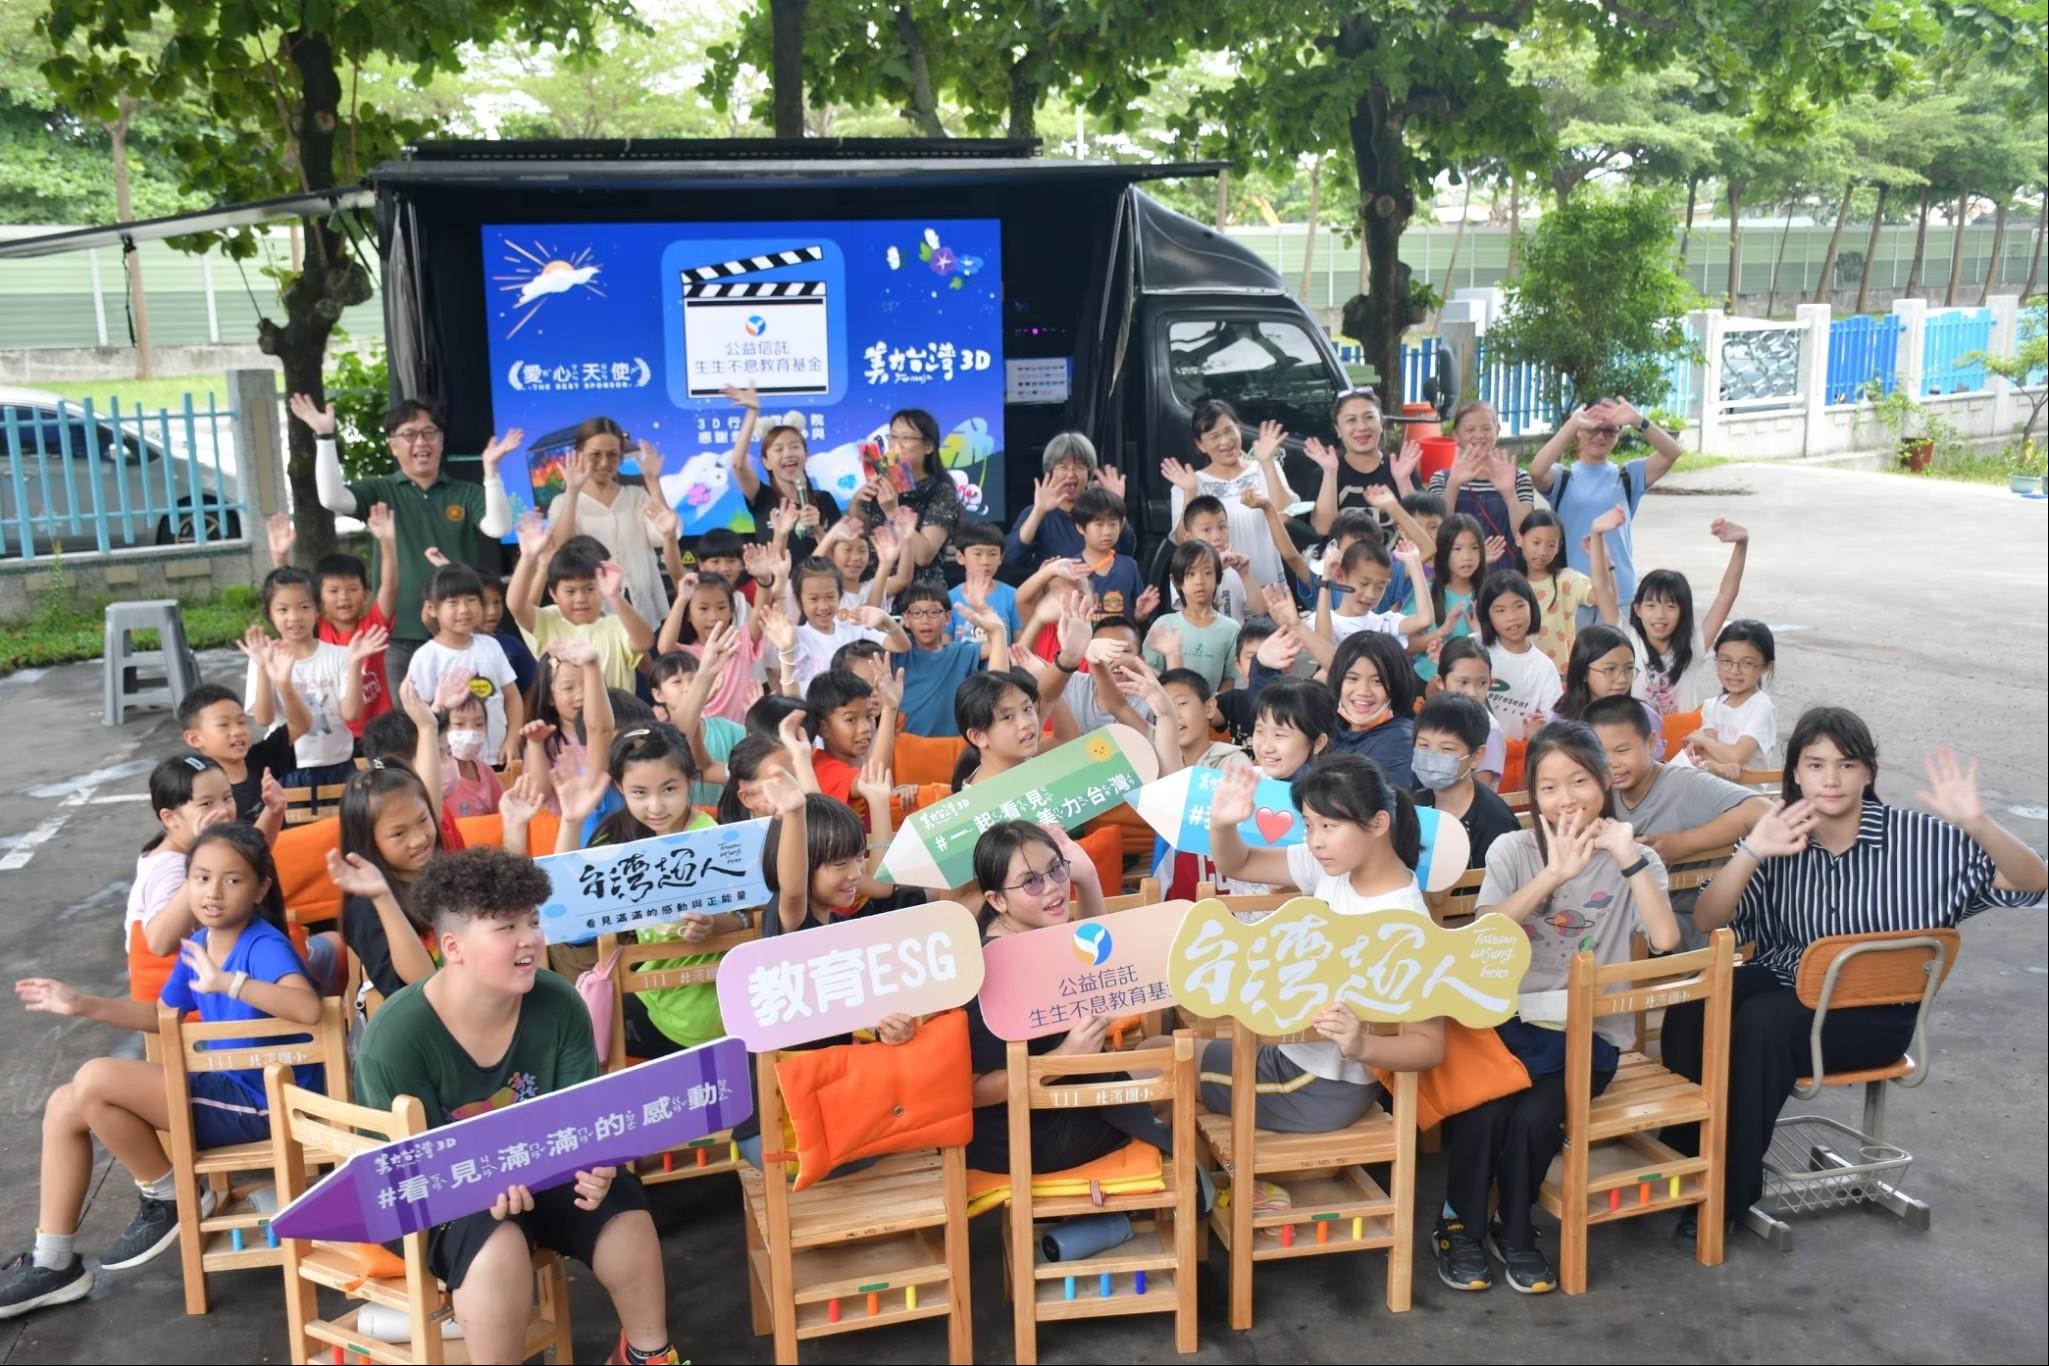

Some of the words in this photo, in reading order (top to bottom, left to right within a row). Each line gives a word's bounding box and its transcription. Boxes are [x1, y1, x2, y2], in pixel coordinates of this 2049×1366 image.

[694, 357, 822, 375] 生生不息教育基金
[726, 341, 791, 356] 公益信託
[522, 361, 637, 384] 愛心天使
[578, 848, 746, 903] 台灣超人
[586, 890, 746, 929] 看見滿滿的感動與正能量
[747, 931, 957, 1027] 教育ESG
[1058, 964, 1138, 998] 公益信託
[1184, 914, 1511, 1028] 台灣超人
[1028, 981, 1173, 1029] 生生不息教育基
[1050, 1090, 1080, 1106] 111
[377, 1079, 732, 1209] #看見滿滿的感動
